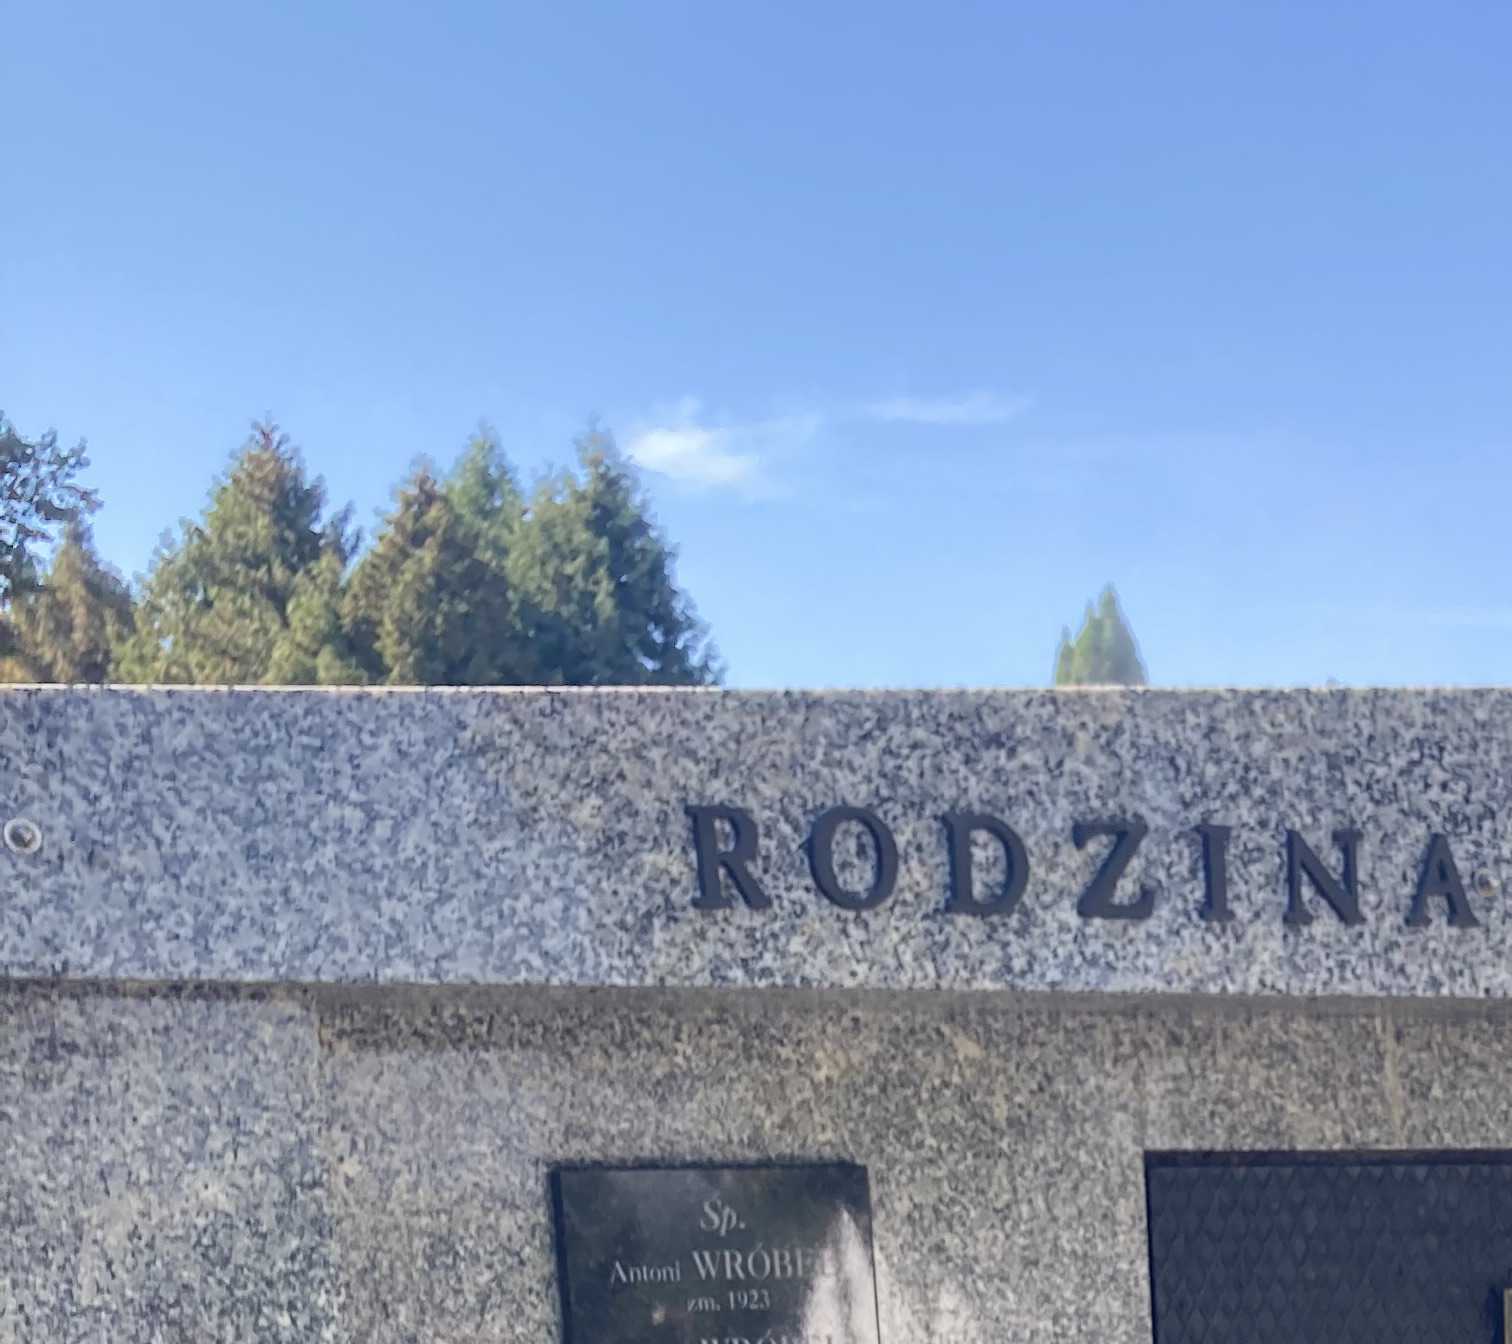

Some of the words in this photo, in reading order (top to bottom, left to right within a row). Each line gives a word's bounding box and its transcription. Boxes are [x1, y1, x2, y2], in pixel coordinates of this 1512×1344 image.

[683, 803, 1482, 928] RODZINA
[610, 1260, 681, 1285] Antoni
[728, 1289, 771, 1310] 1923
